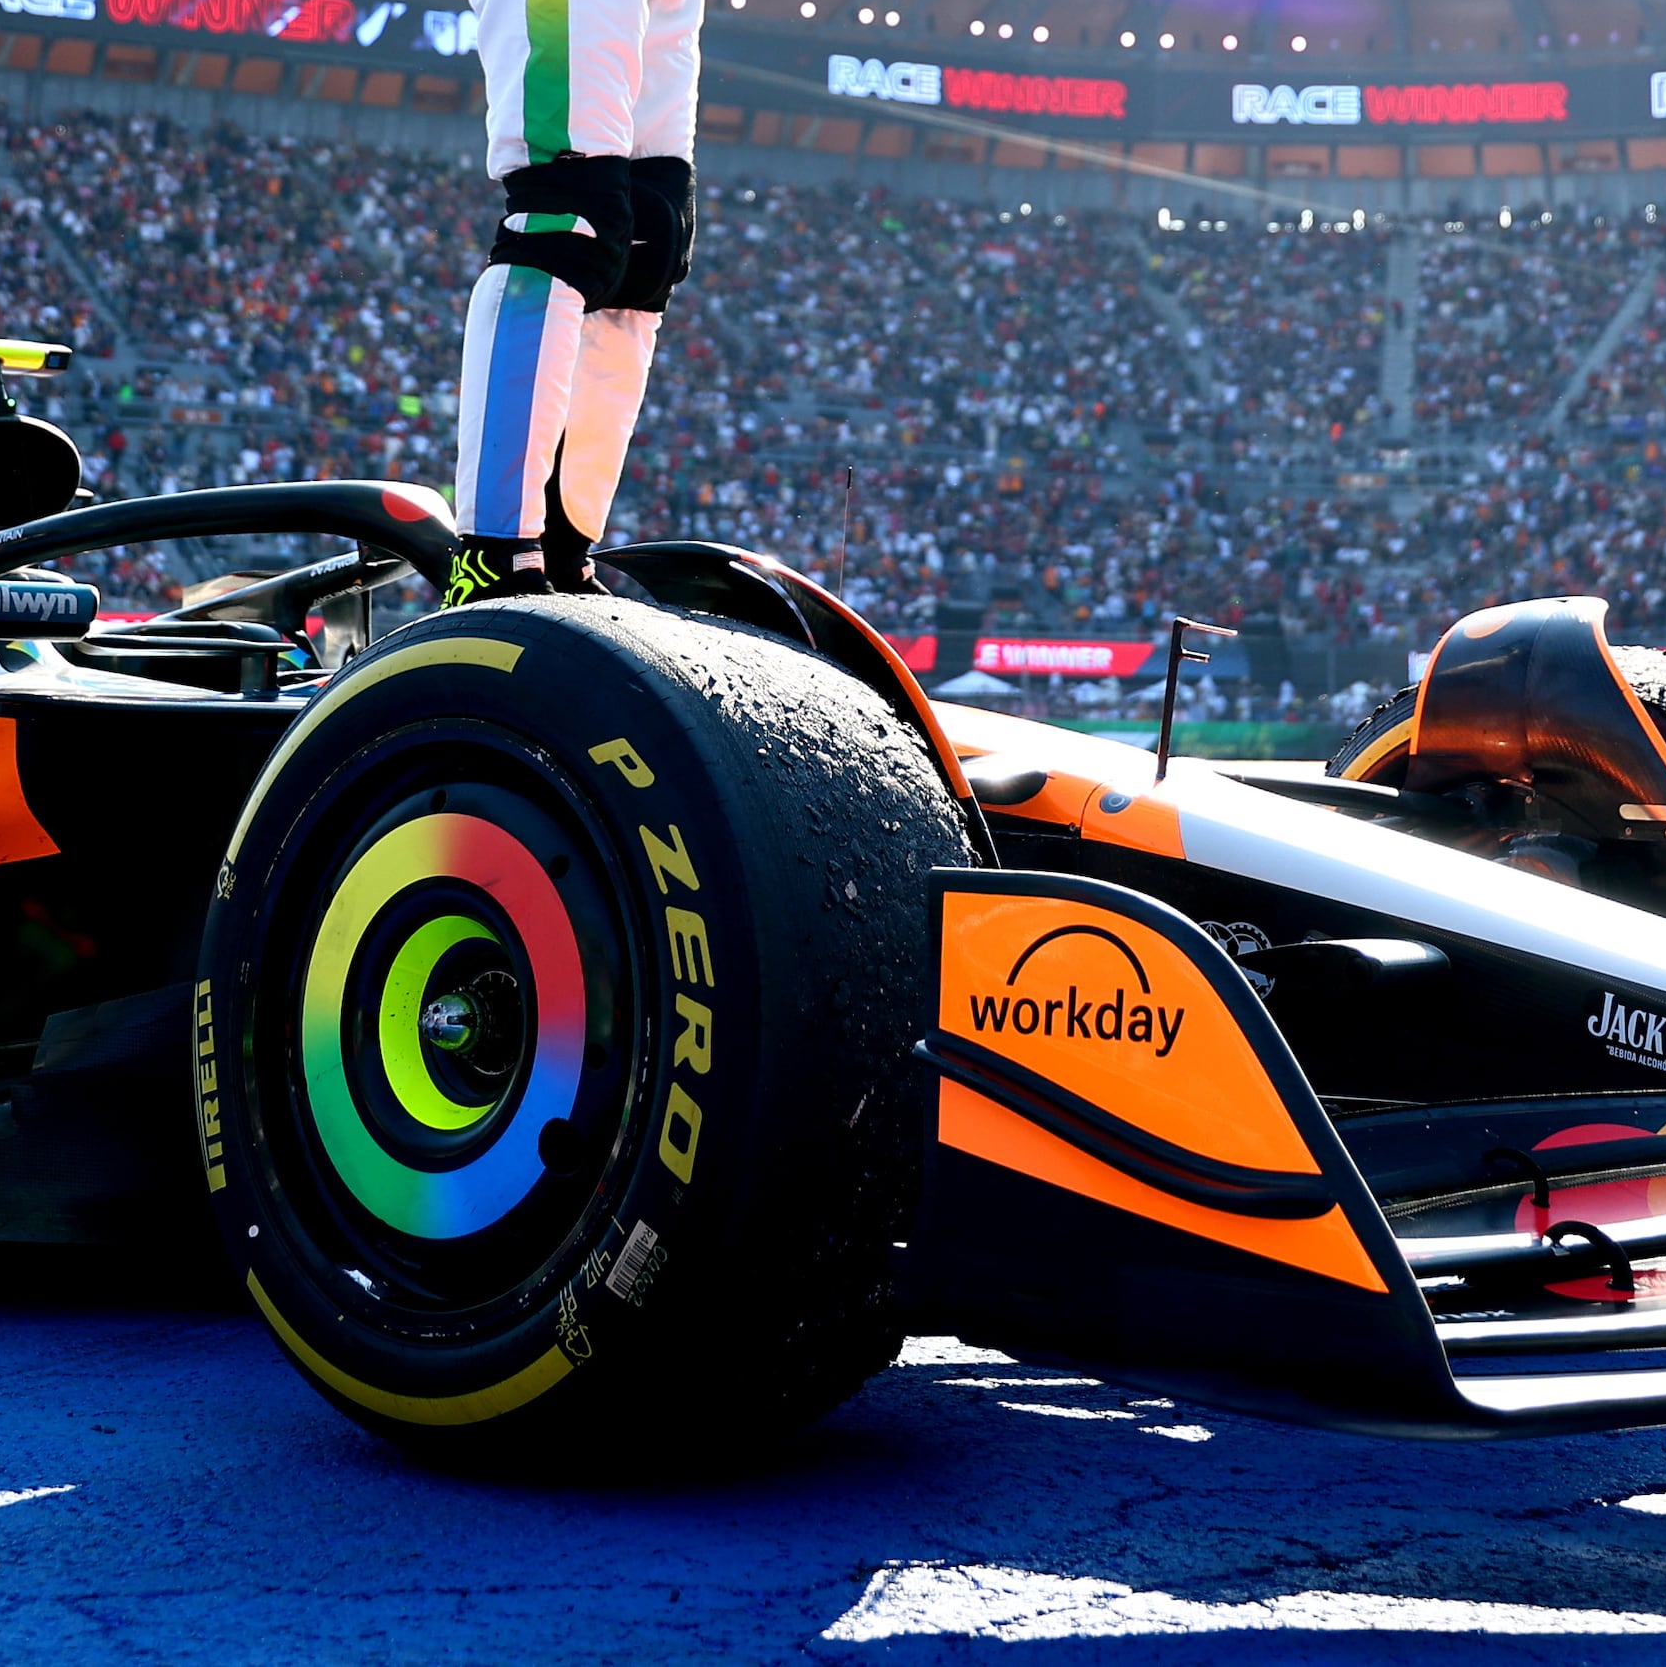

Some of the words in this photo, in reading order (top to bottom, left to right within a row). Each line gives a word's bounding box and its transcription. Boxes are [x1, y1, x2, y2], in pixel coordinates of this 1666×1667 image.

[827, 53, 942, 106] RACE
[943, 65, 1128, 121] WINNER
[1231, 83, 1362, 126] RACE
[1364, 81, 1569, 126] WINNER
[588, 737, 656, 789] P
[637, 822, 716, 1186] ZERO
[969, 985, 1185, 1058] workday
[193, 977, 228, 1195] PIRELLI
